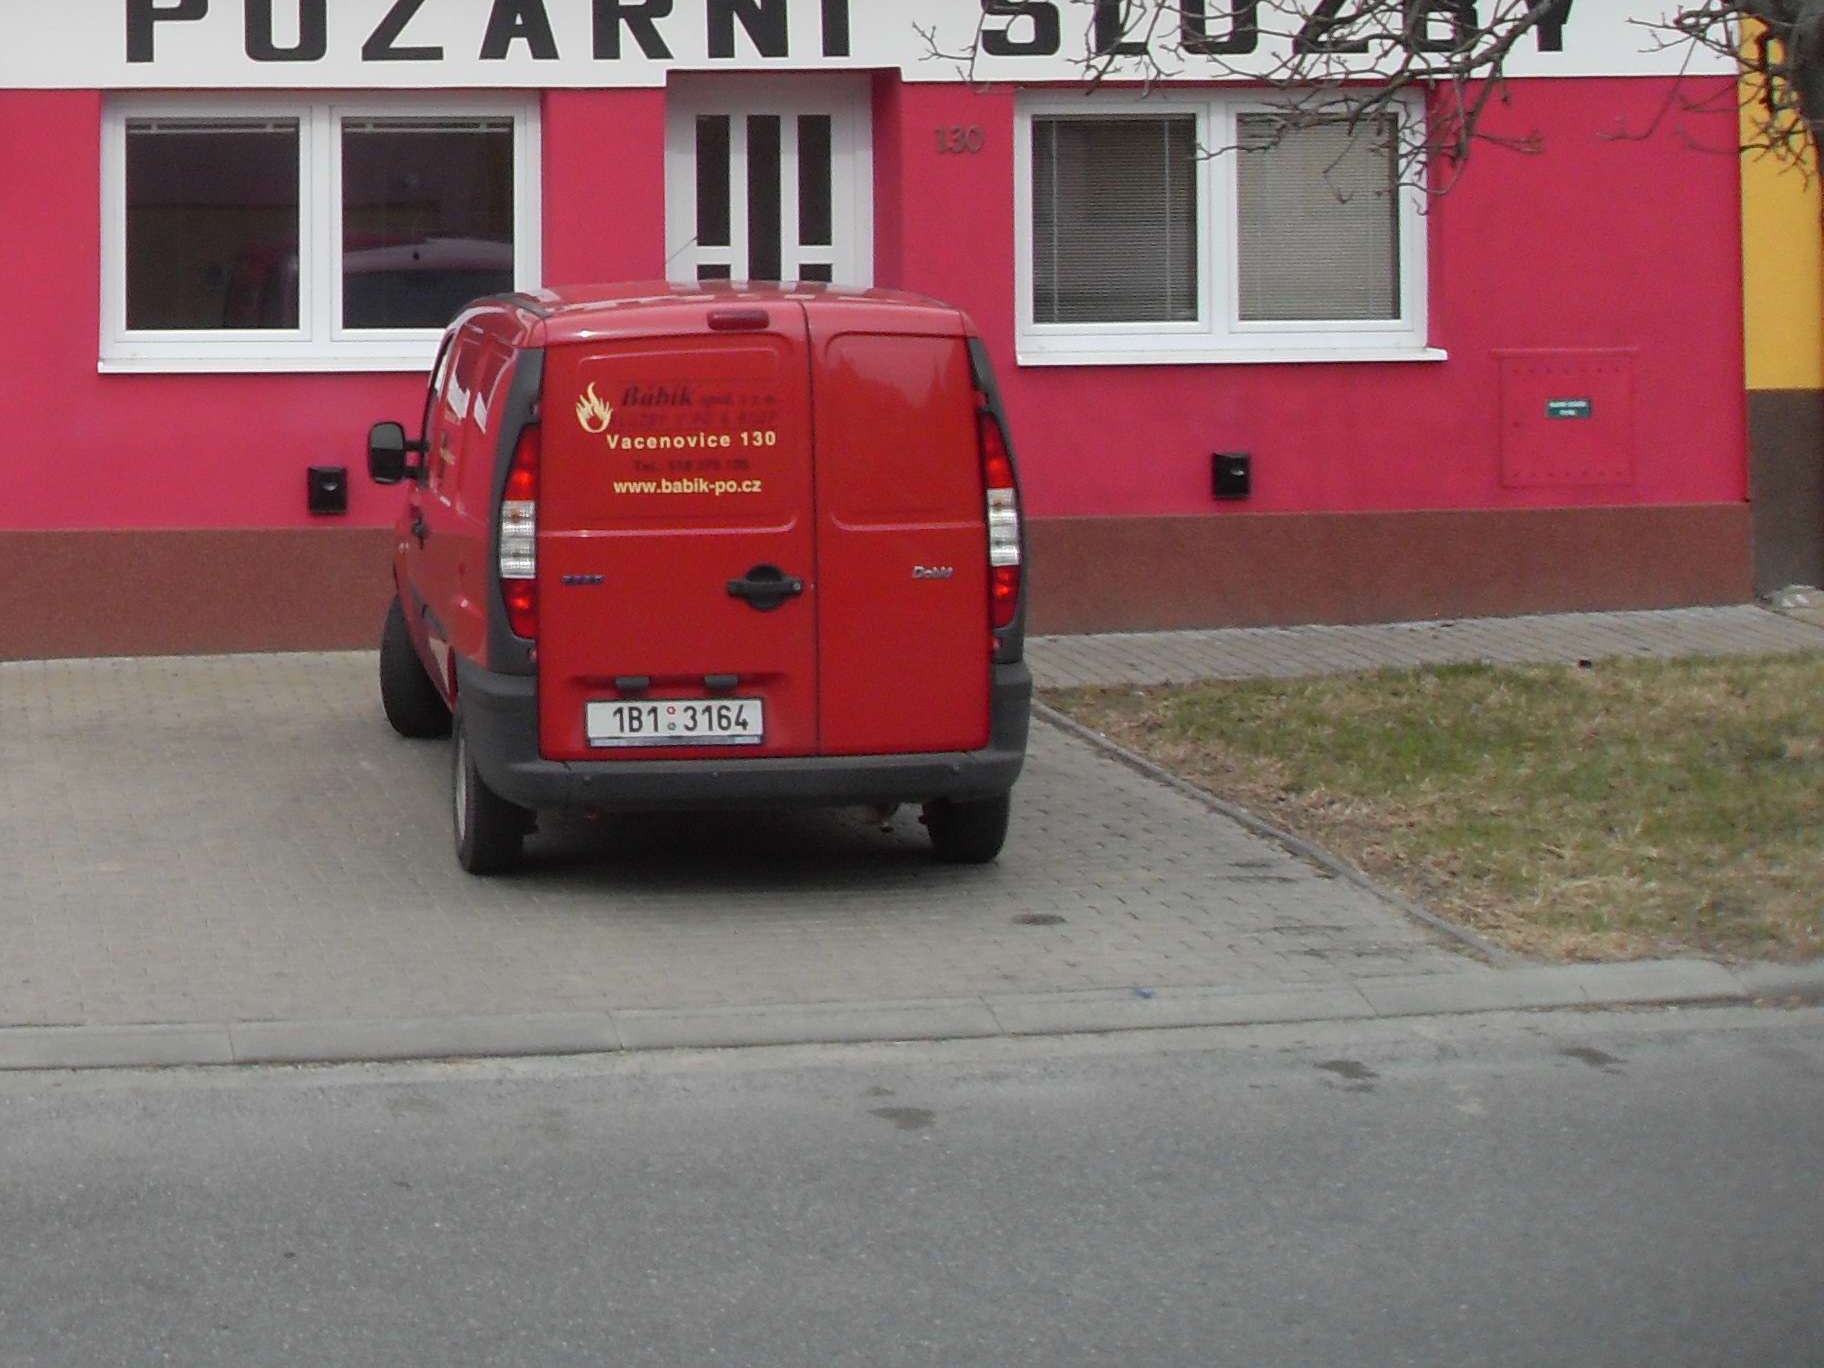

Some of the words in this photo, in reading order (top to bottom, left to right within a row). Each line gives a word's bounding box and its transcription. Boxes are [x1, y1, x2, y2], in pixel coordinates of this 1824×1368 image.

[935, 125, 985, 154] 130
[606, 432, 731, 450] Vacenovice
[740, 430, 776, 447] 130
[613, 477, 762, 497] www.babik-po.cz
[613, 705, 659, 733] 1B1
[683, 704, 749, 732] 3164
